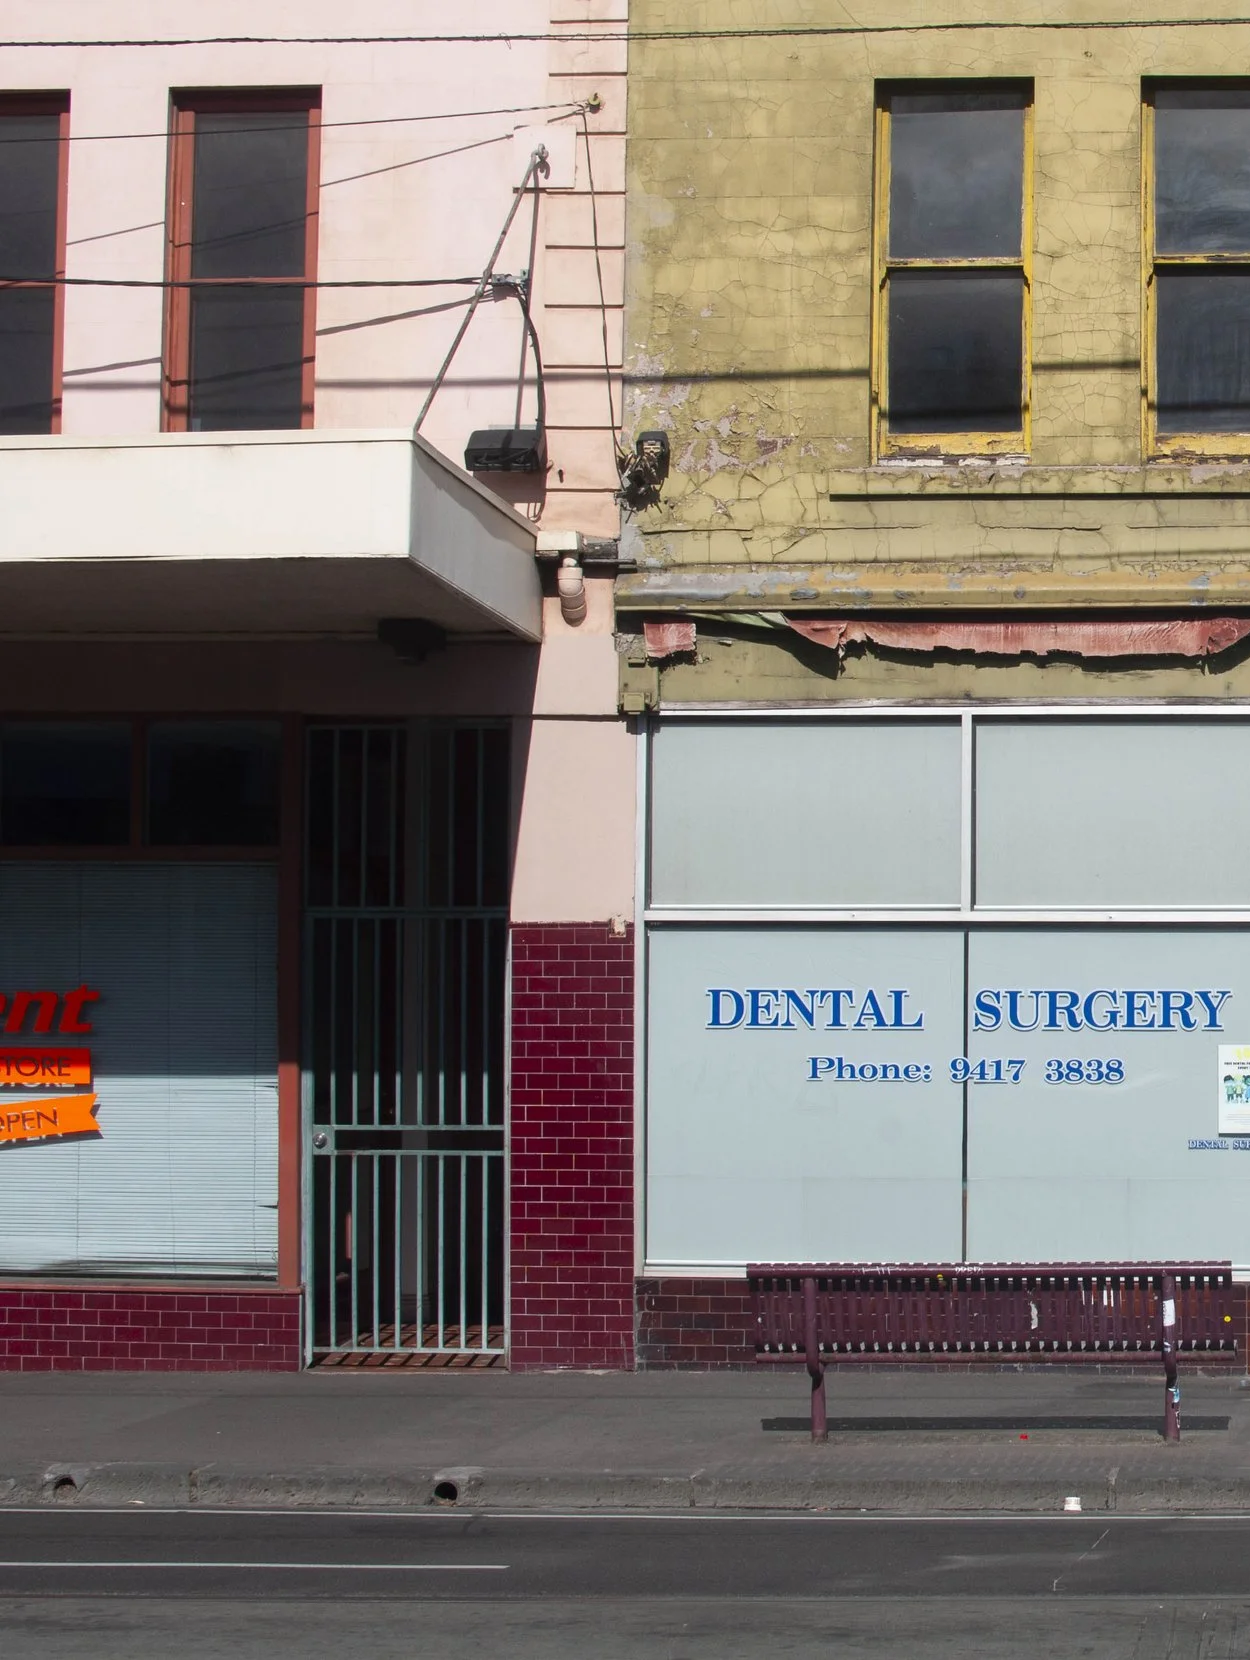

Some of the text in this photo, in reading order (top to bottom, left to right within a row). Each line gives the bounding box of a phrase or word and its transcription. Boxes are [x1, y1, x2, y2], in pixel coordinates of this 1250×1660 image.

[0, 984, 100, 1033] nt
[706, 988, 1233, 1031] DENTAL SURGERY
[0, 1056, 71, 1077] TORE
[807, 1057, 1125, 1083] Phone: 9417 3838
[0, 1106, 58, 1132] PEN
[1188, 1140, 1228, 1149] DENTAL
